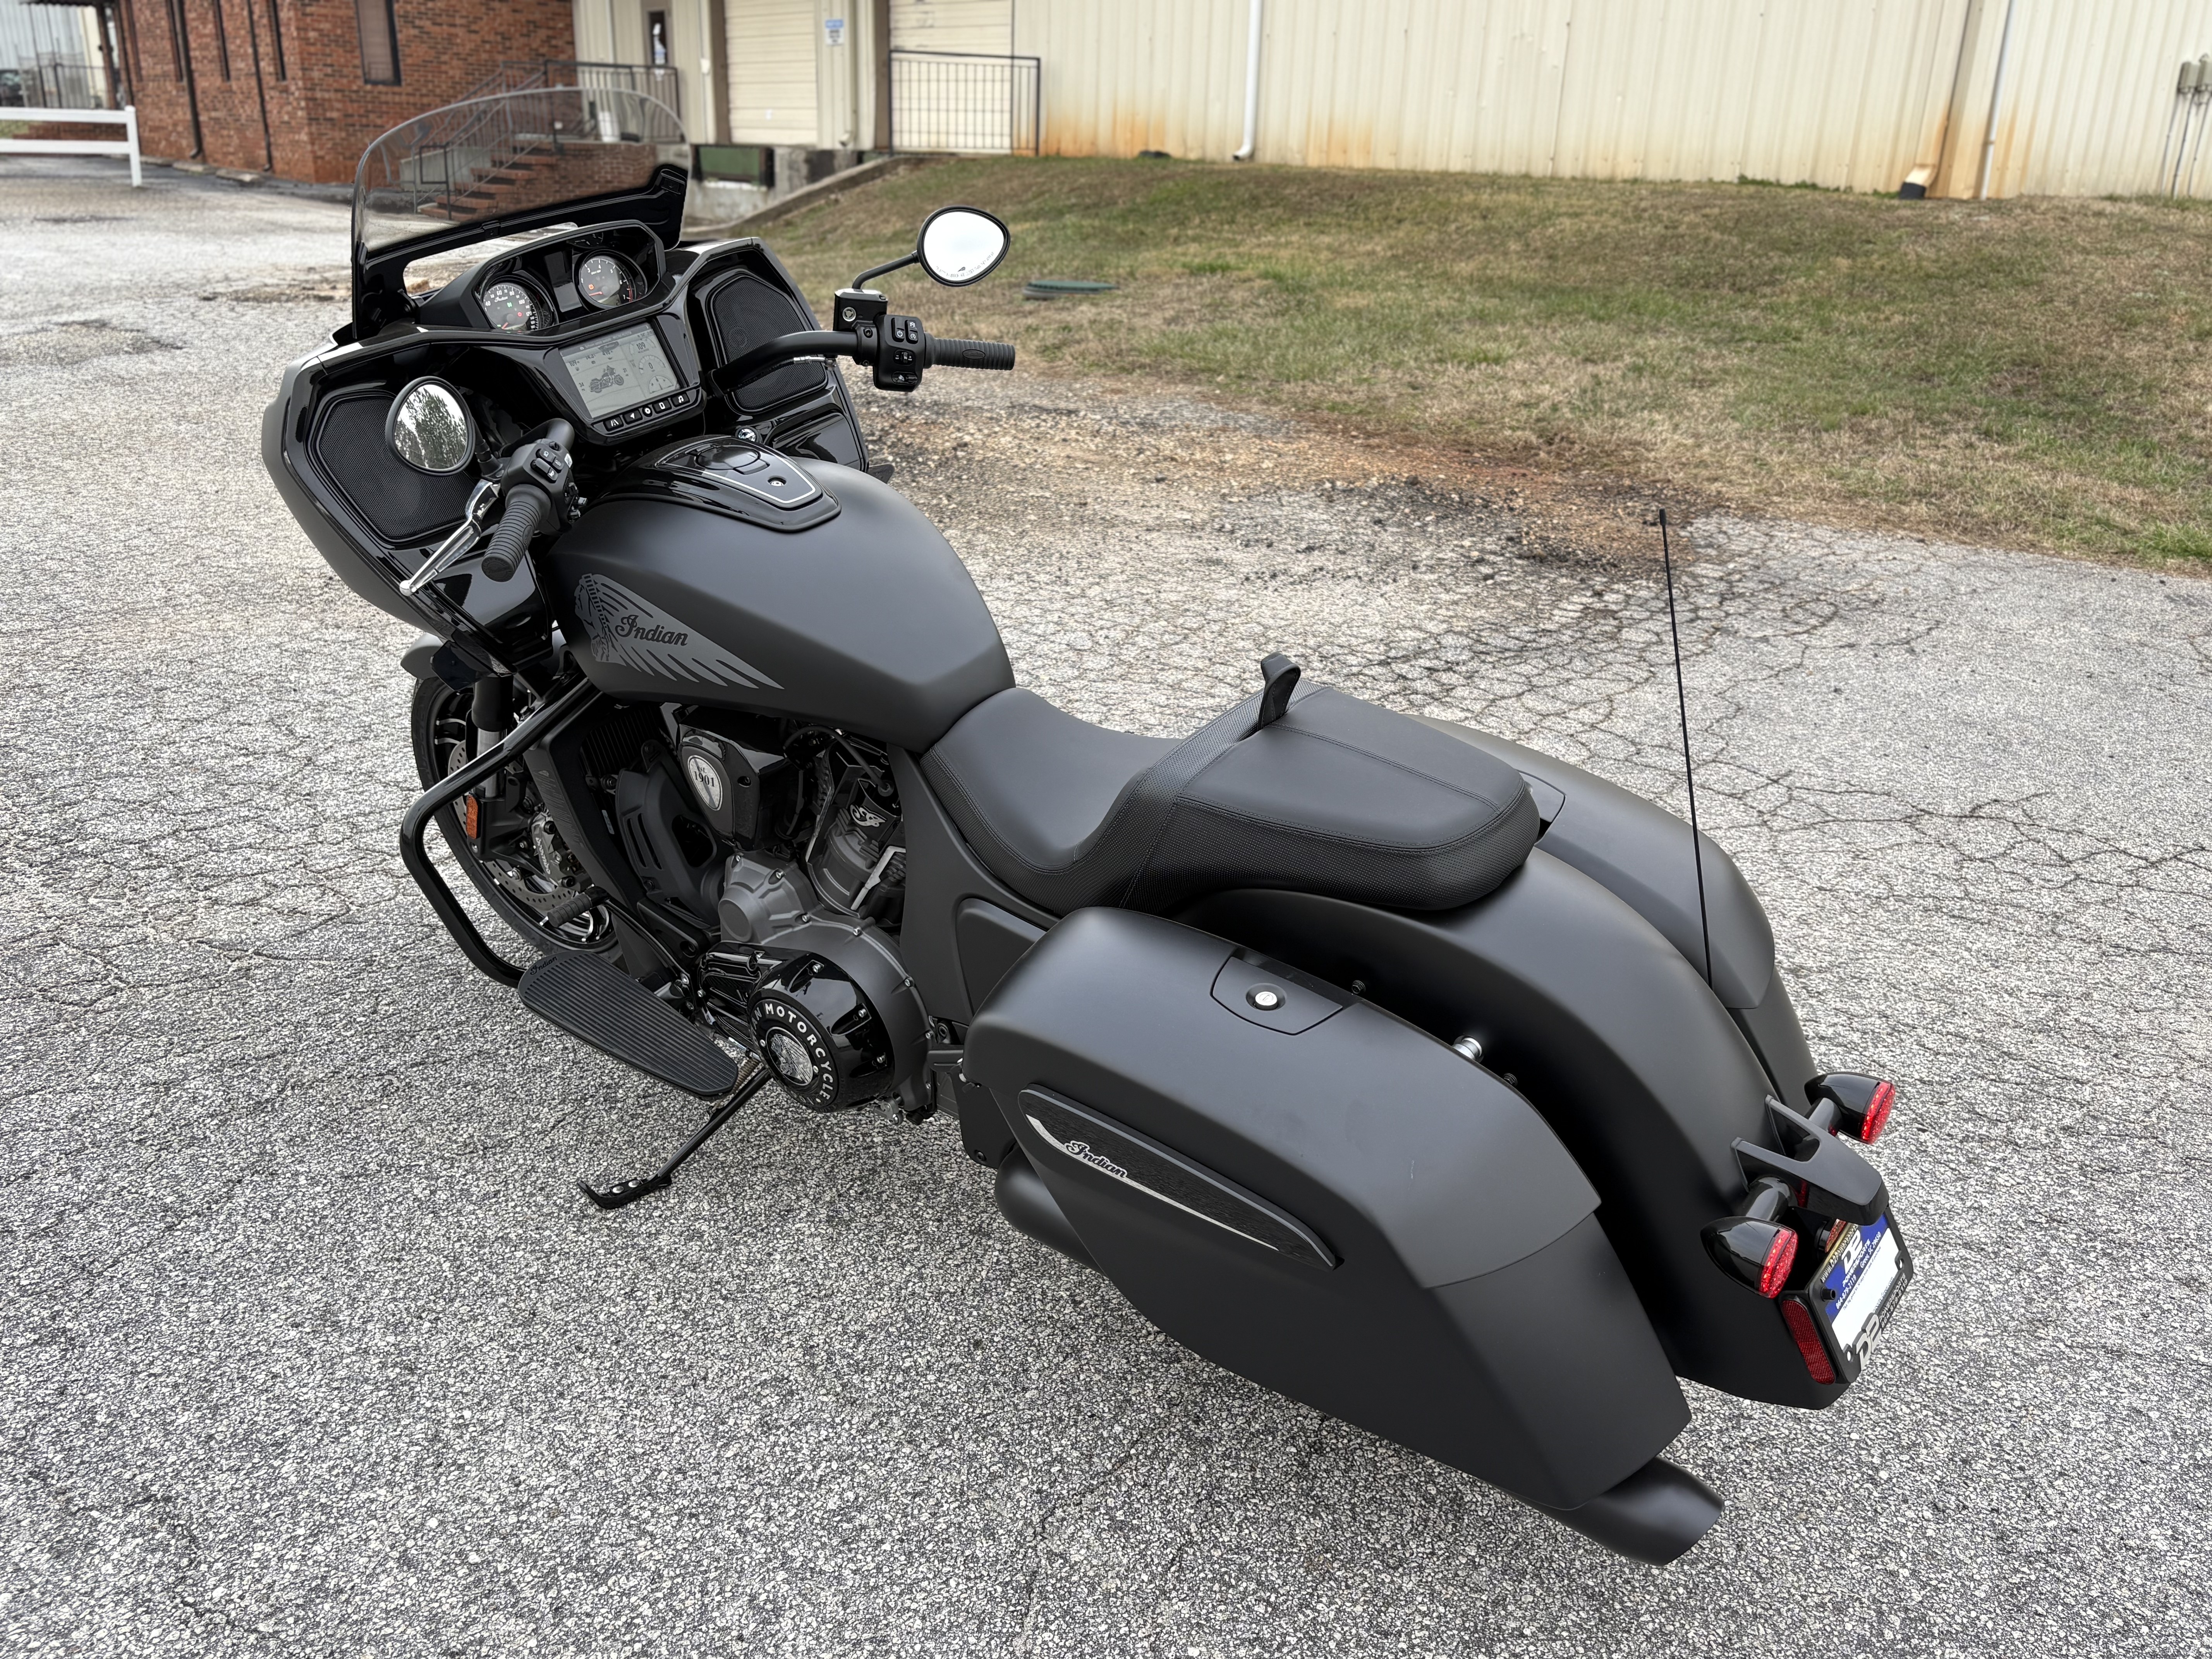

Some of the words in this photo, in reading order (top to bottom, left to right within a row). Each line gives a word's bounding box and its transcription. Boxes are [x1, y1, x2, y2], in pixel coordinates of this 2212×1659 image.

[636, 342, 646, 350] 109
[615, 614, 688, 646] Indian
[694, 771, 714, 787] 1901
[530, 956, 557, 975] Indian
[765, 1003, 833, 1100] MOTORCYCLE
[1065, 1142, 1126, 1178] Indian
[1836, 1274, 1856, 1309] 864-879-2119
[1868, 1245, 1874, 1255] SC
